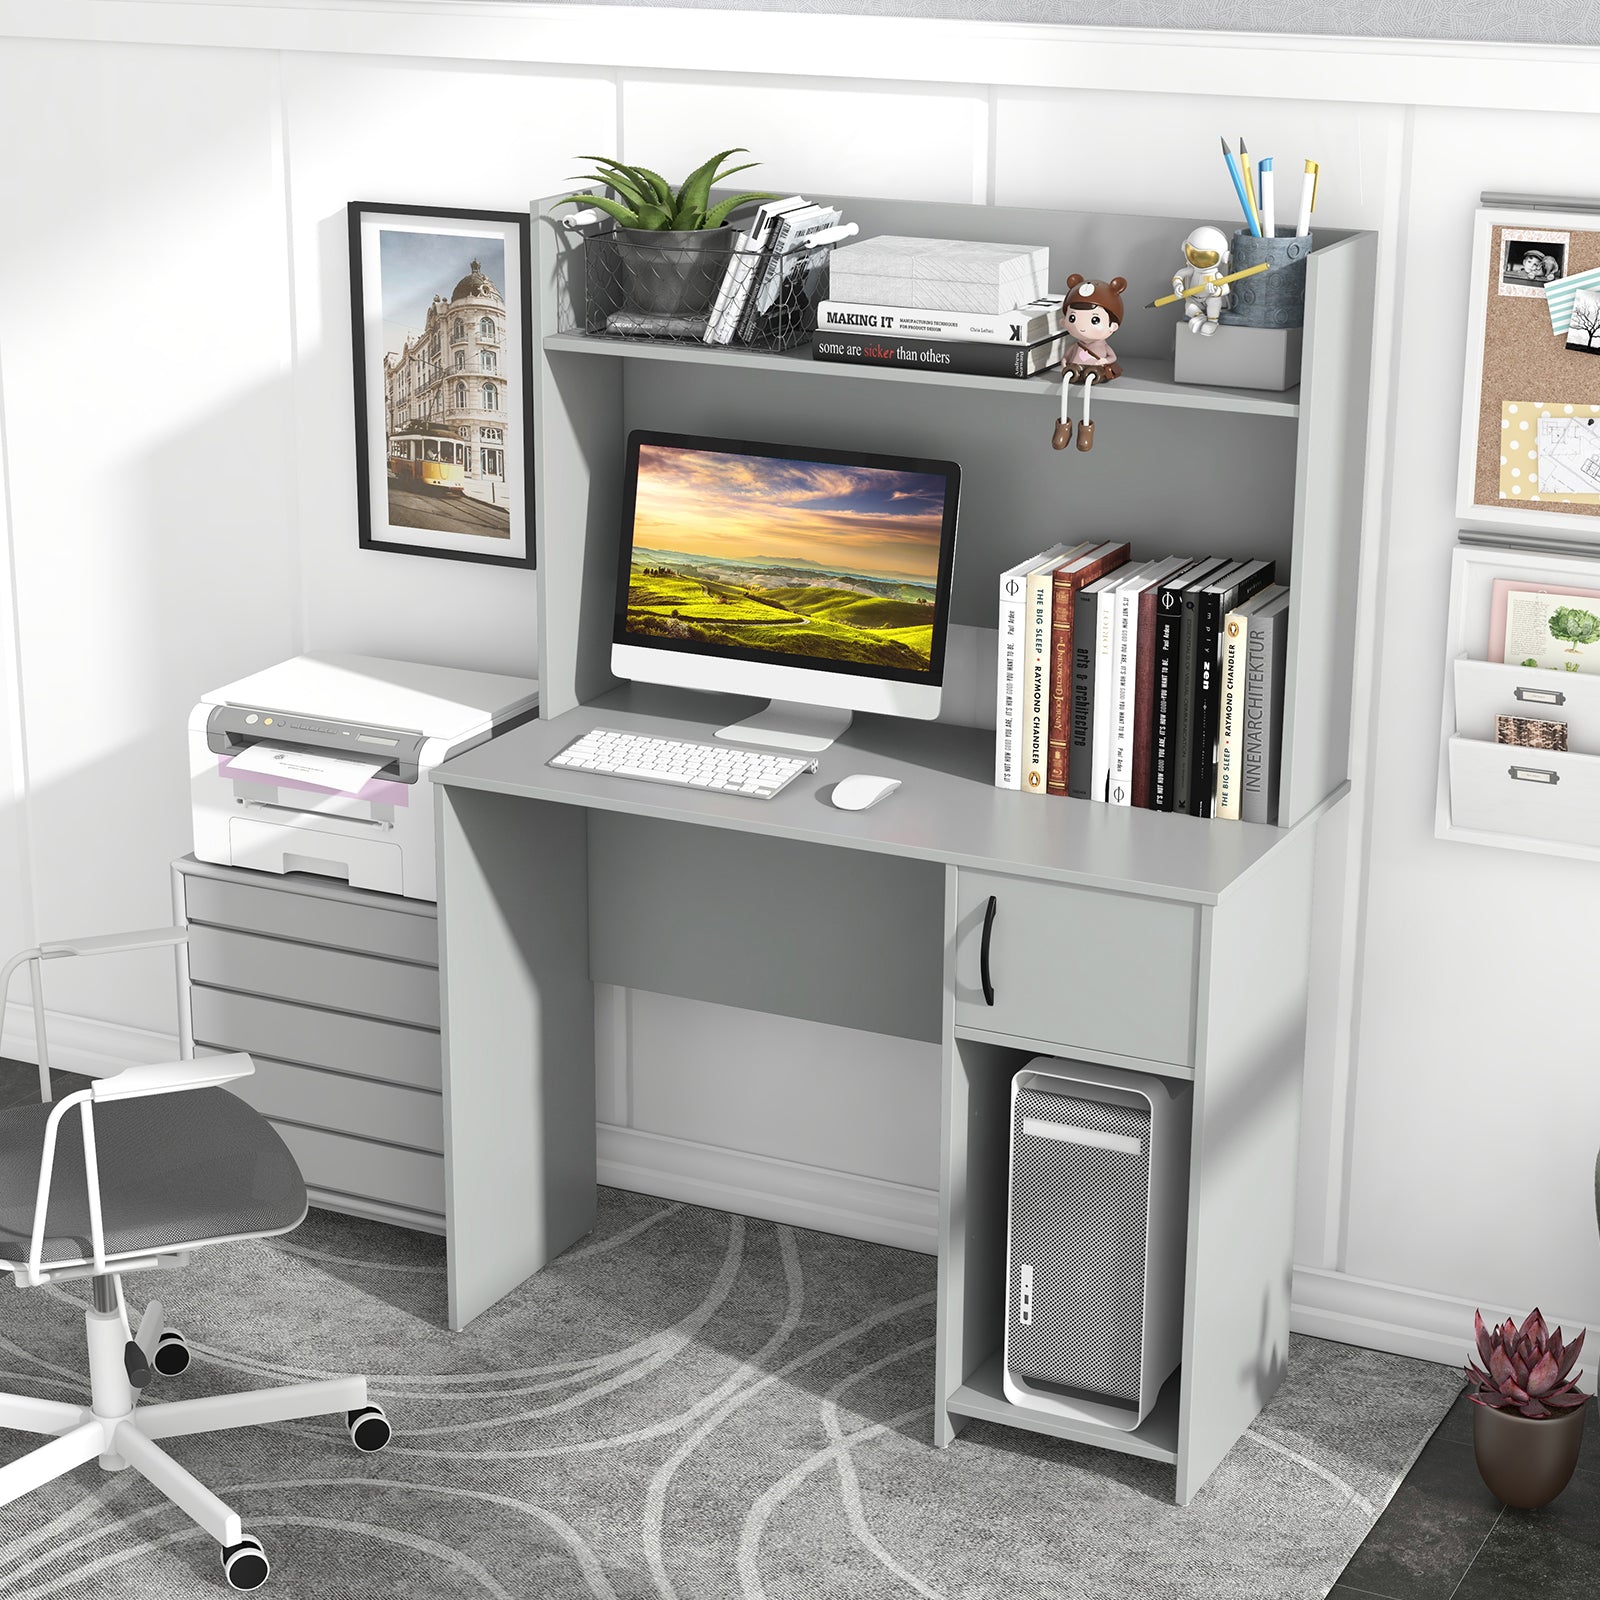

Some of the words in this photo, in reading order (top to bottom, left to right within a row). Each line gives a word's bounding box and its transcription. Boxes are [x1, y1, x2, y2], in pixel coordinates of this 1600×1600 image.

[826, 311, 878, 328] MAKING
[881, 316, 894, 328] IT
[900, 318, 934, 327] MANUFACTURING
[818, 342, 845, 355] some
[847, 344, 862, 356] are
[863, 343, 895, 359] sicker
[897, 346, 918, 361] than
[920, 349, 951, 364] others
[1035, 629, 1043, 653] SLEEP
[1056, 643, 1065, 695] UNEXPECTED
[1077, 649, 1089, 668] arts
[1185, 662, 1190, 672] OF
[1227, 644, 1235, 689] CHANDLER
[1202, 661, 1210, 690] zen
[1054, 695, 1064, 730] JOURNEY
[1074, 685, 1089, 747] architecture
[1225, 693, 1233, 736] RAYMOND
[1246, 630, 1265, 793] INNENARCHITEKTUR
[1032, 717, 1040, 764] CHANDLER
